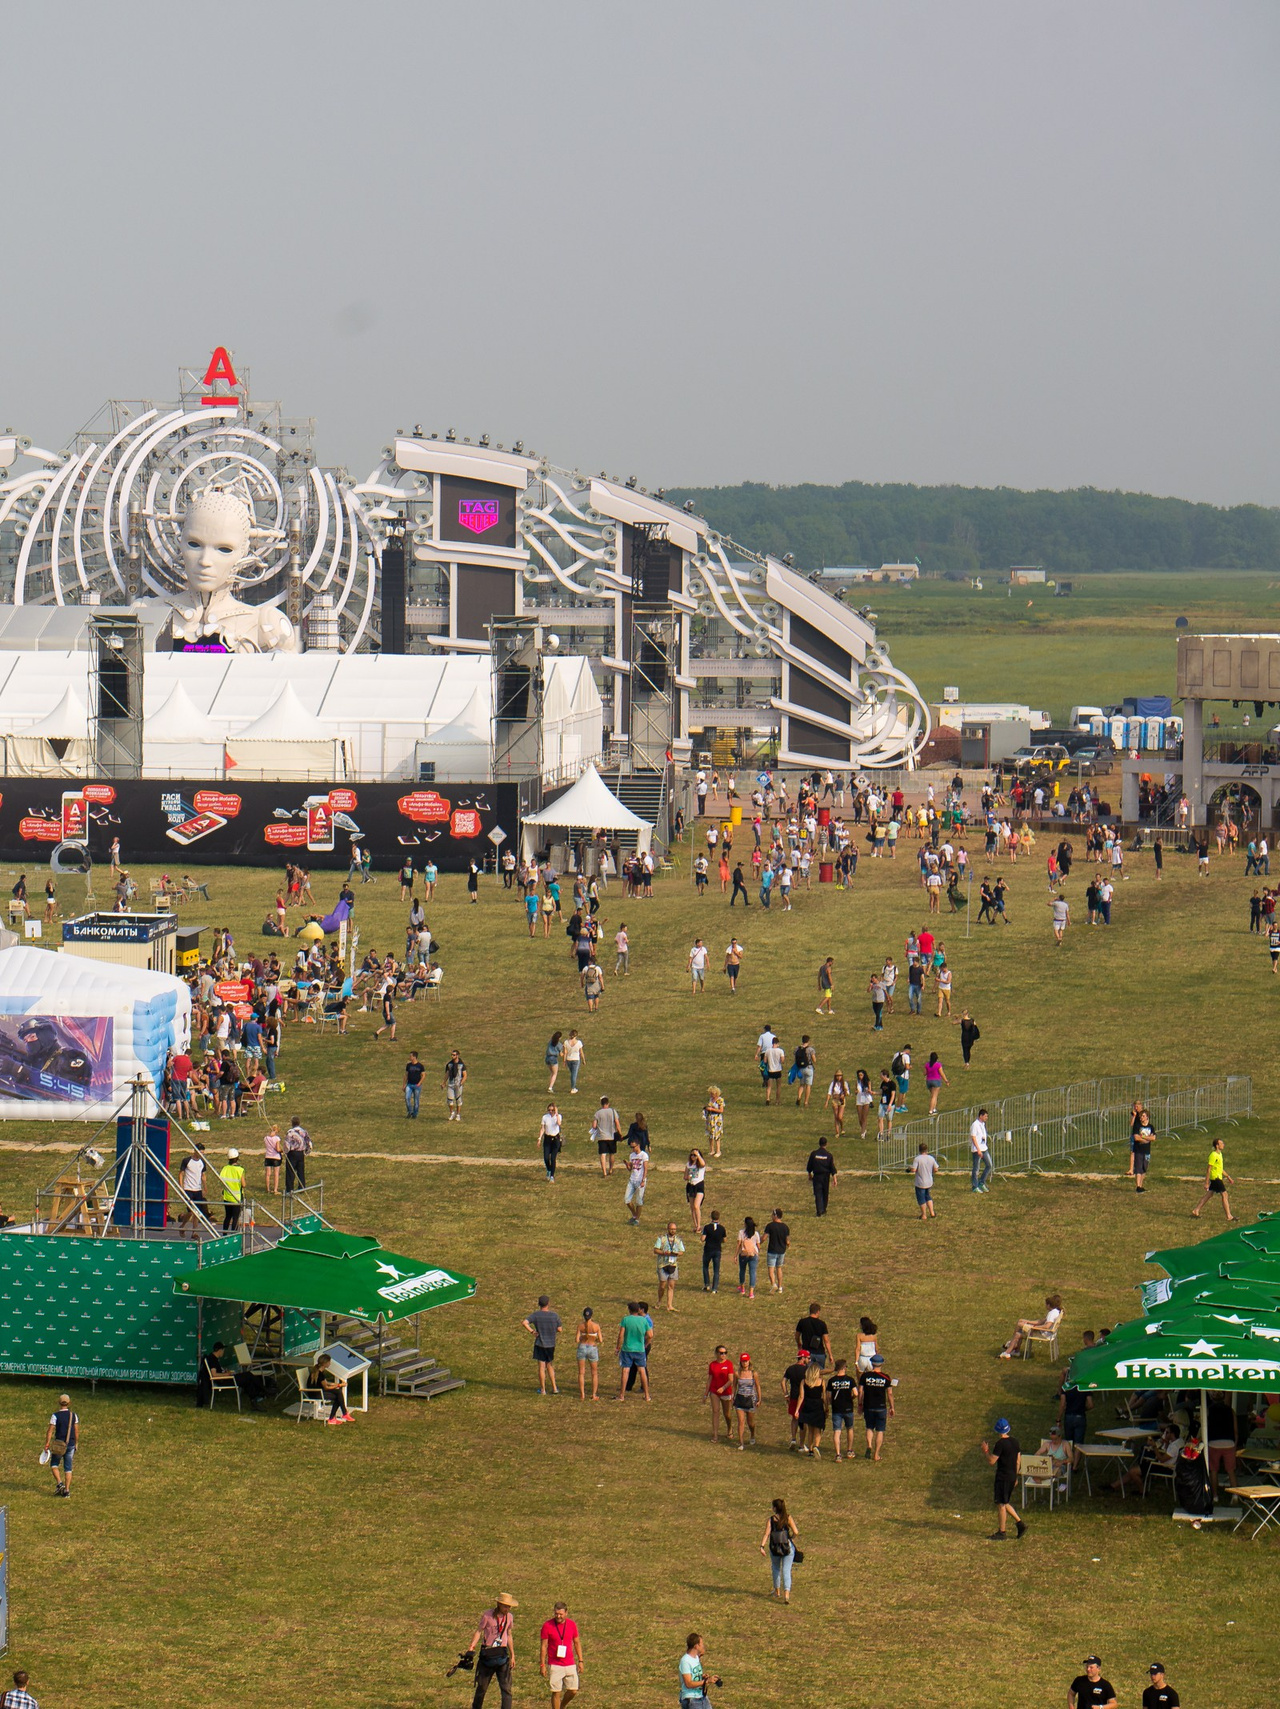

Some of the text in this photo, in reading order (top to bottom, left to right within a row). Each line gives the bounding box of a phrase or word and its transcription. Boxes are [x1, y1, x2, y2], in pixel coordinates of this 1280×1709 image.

[462, 502, 495, 513] TAG
[461, 514, 497, 530] HEUER
[73, 926, 138, 937] БАНКОМАТЫ
[40, 1073, 84, 1099] 5:45
[384, 1277, 455, 1302] Heineken
[27, 1364, 63, 1373] УПОТРЕБЛЕНИЕ
[64, 1365, 99, 1376] АЛКОГОЛЬНОЙ
[99, 1368, 129, 1377] ПРОДУКЦИИ
[130, 1369, 149, 1379] ВРЕДИТ
[149, 1370, 170, 1380] ВАШЕМУ
[1124, 1363, 1280, 1380] Heineken
